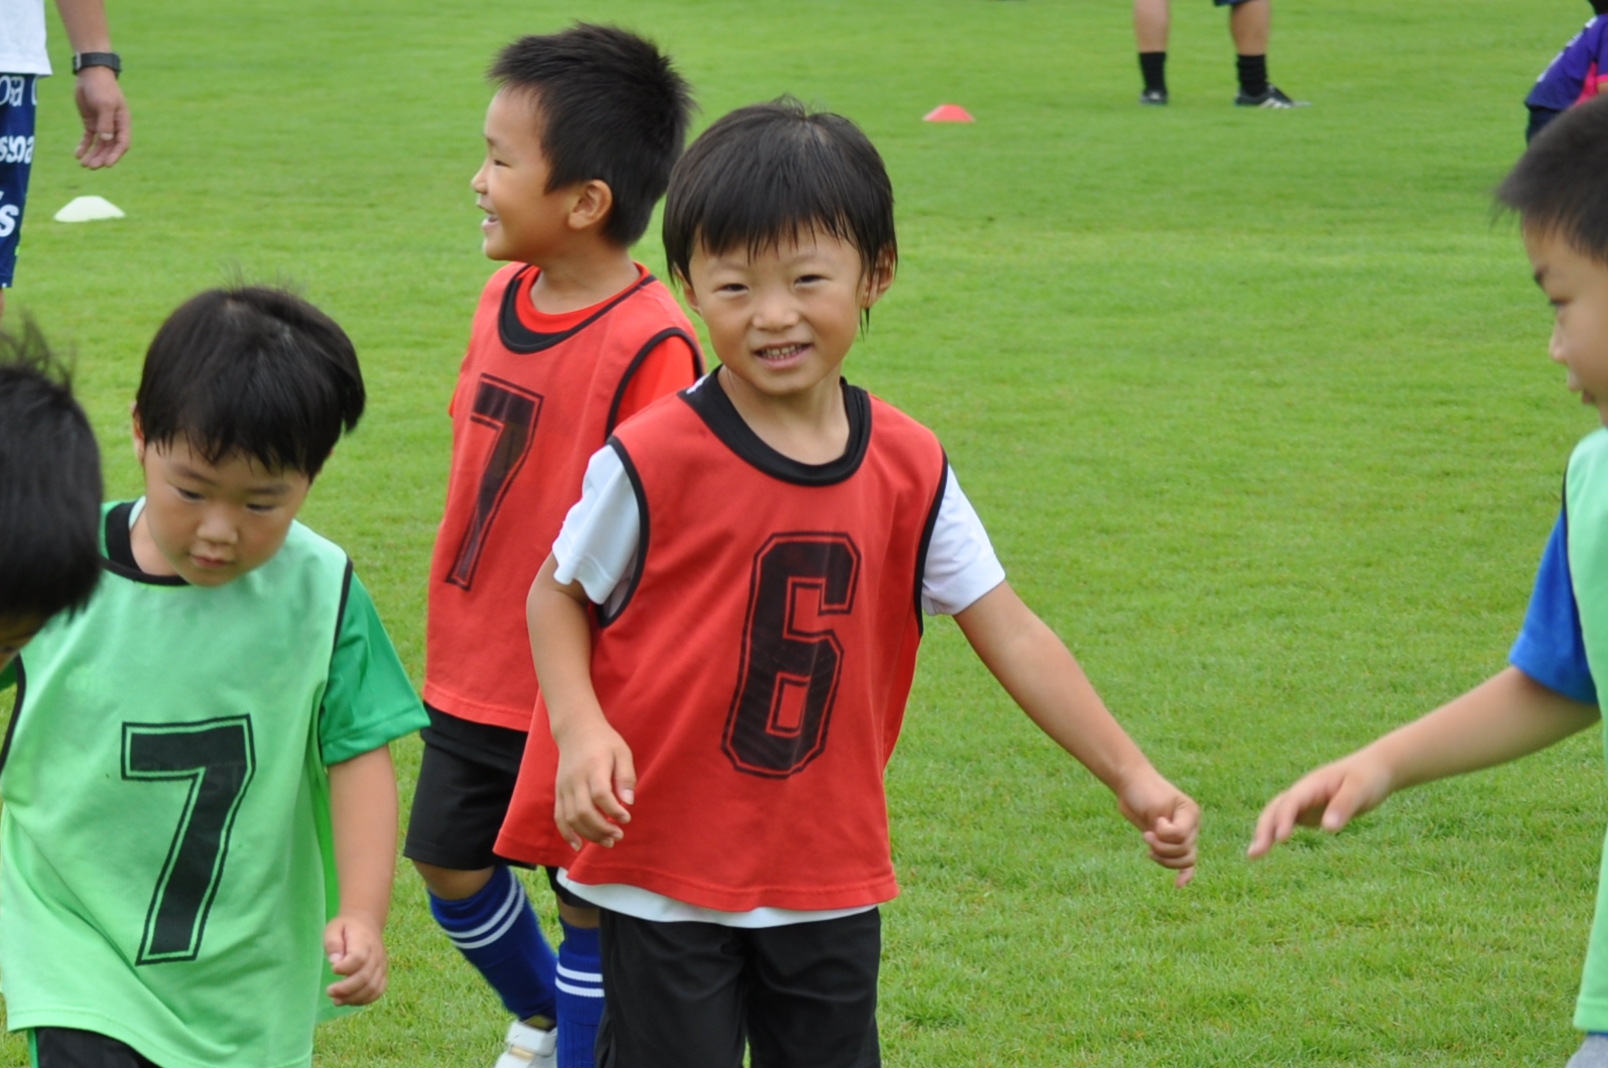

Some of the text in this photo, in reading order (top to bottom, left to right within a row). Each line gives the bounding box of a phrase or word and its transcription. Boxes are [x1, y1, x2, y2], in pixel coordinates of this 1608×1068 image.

[445, 372, 545, 592] 7
[720, 531, 861, 780] 6
[121, 713, 256, 966] 7
